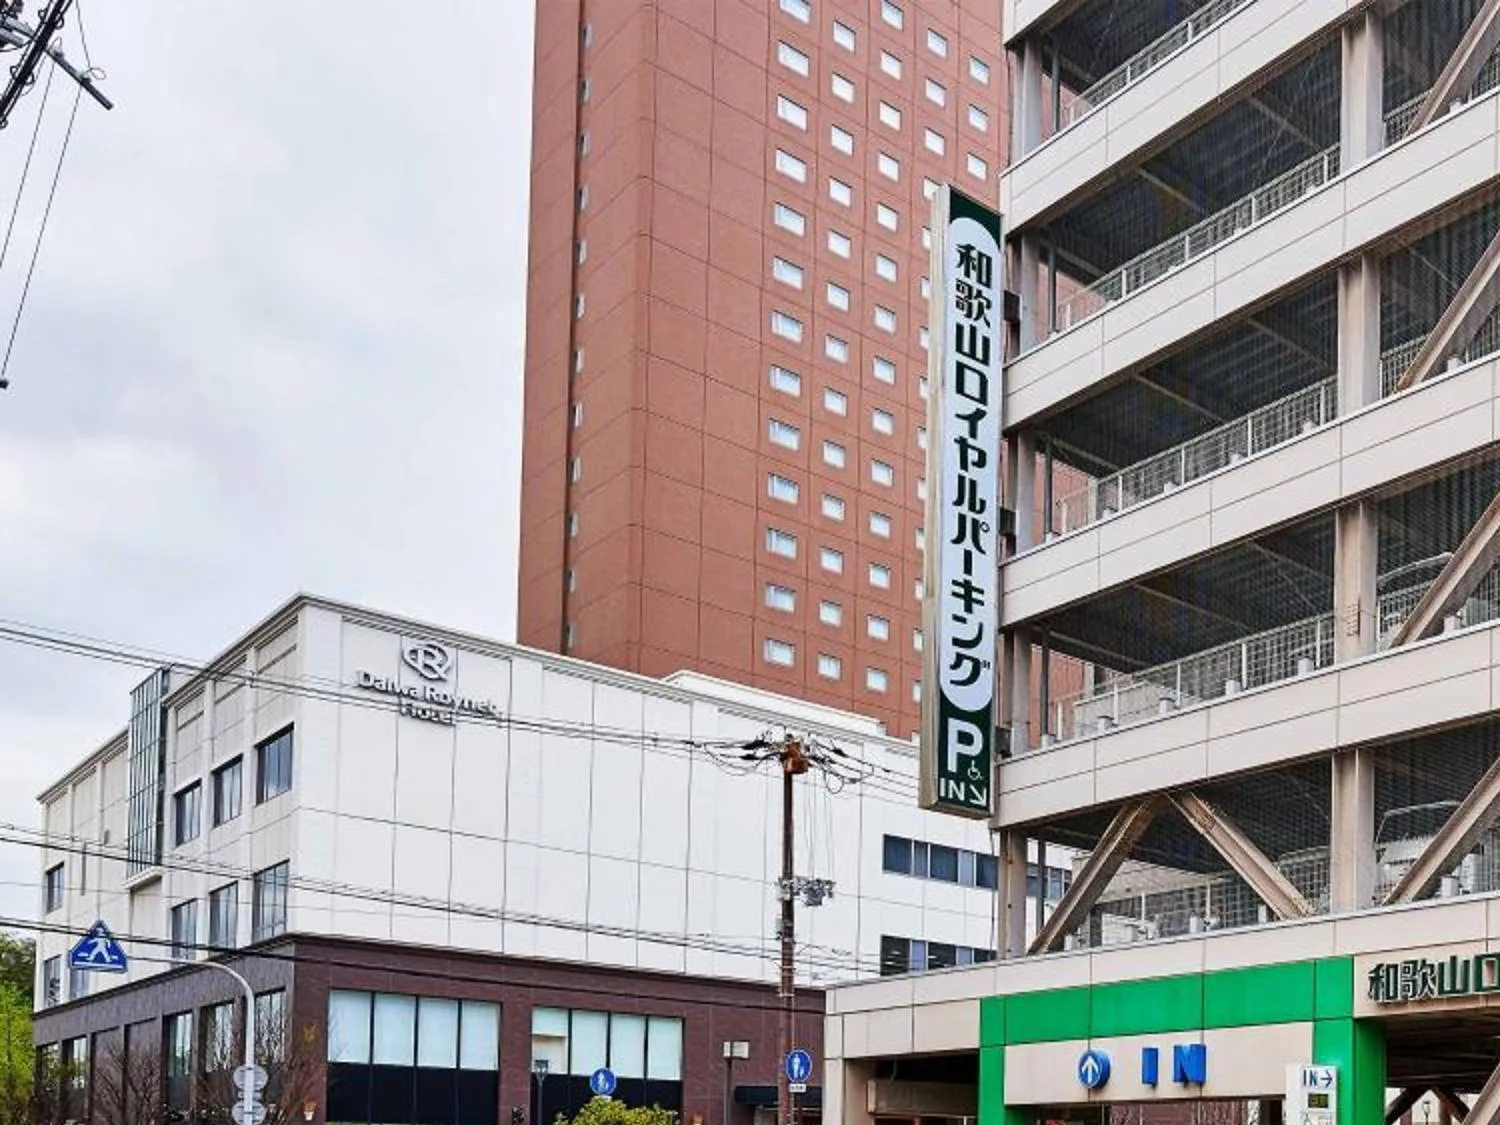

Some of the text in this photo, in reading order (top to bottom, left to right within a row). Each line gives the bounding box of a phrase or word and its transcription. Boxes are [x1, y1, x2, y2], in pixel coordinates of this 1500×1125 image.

[950, 241, 992, 688] 和歌山ロイヤルパーキング
[359, 671, 419, 697] Daiwa
[947, 717, 984, 773] P
[940, 777, 965, 801] IN
[1142, 1043, 1206, 1087] IN
[1303, 1069, 1317, 1086] IN
